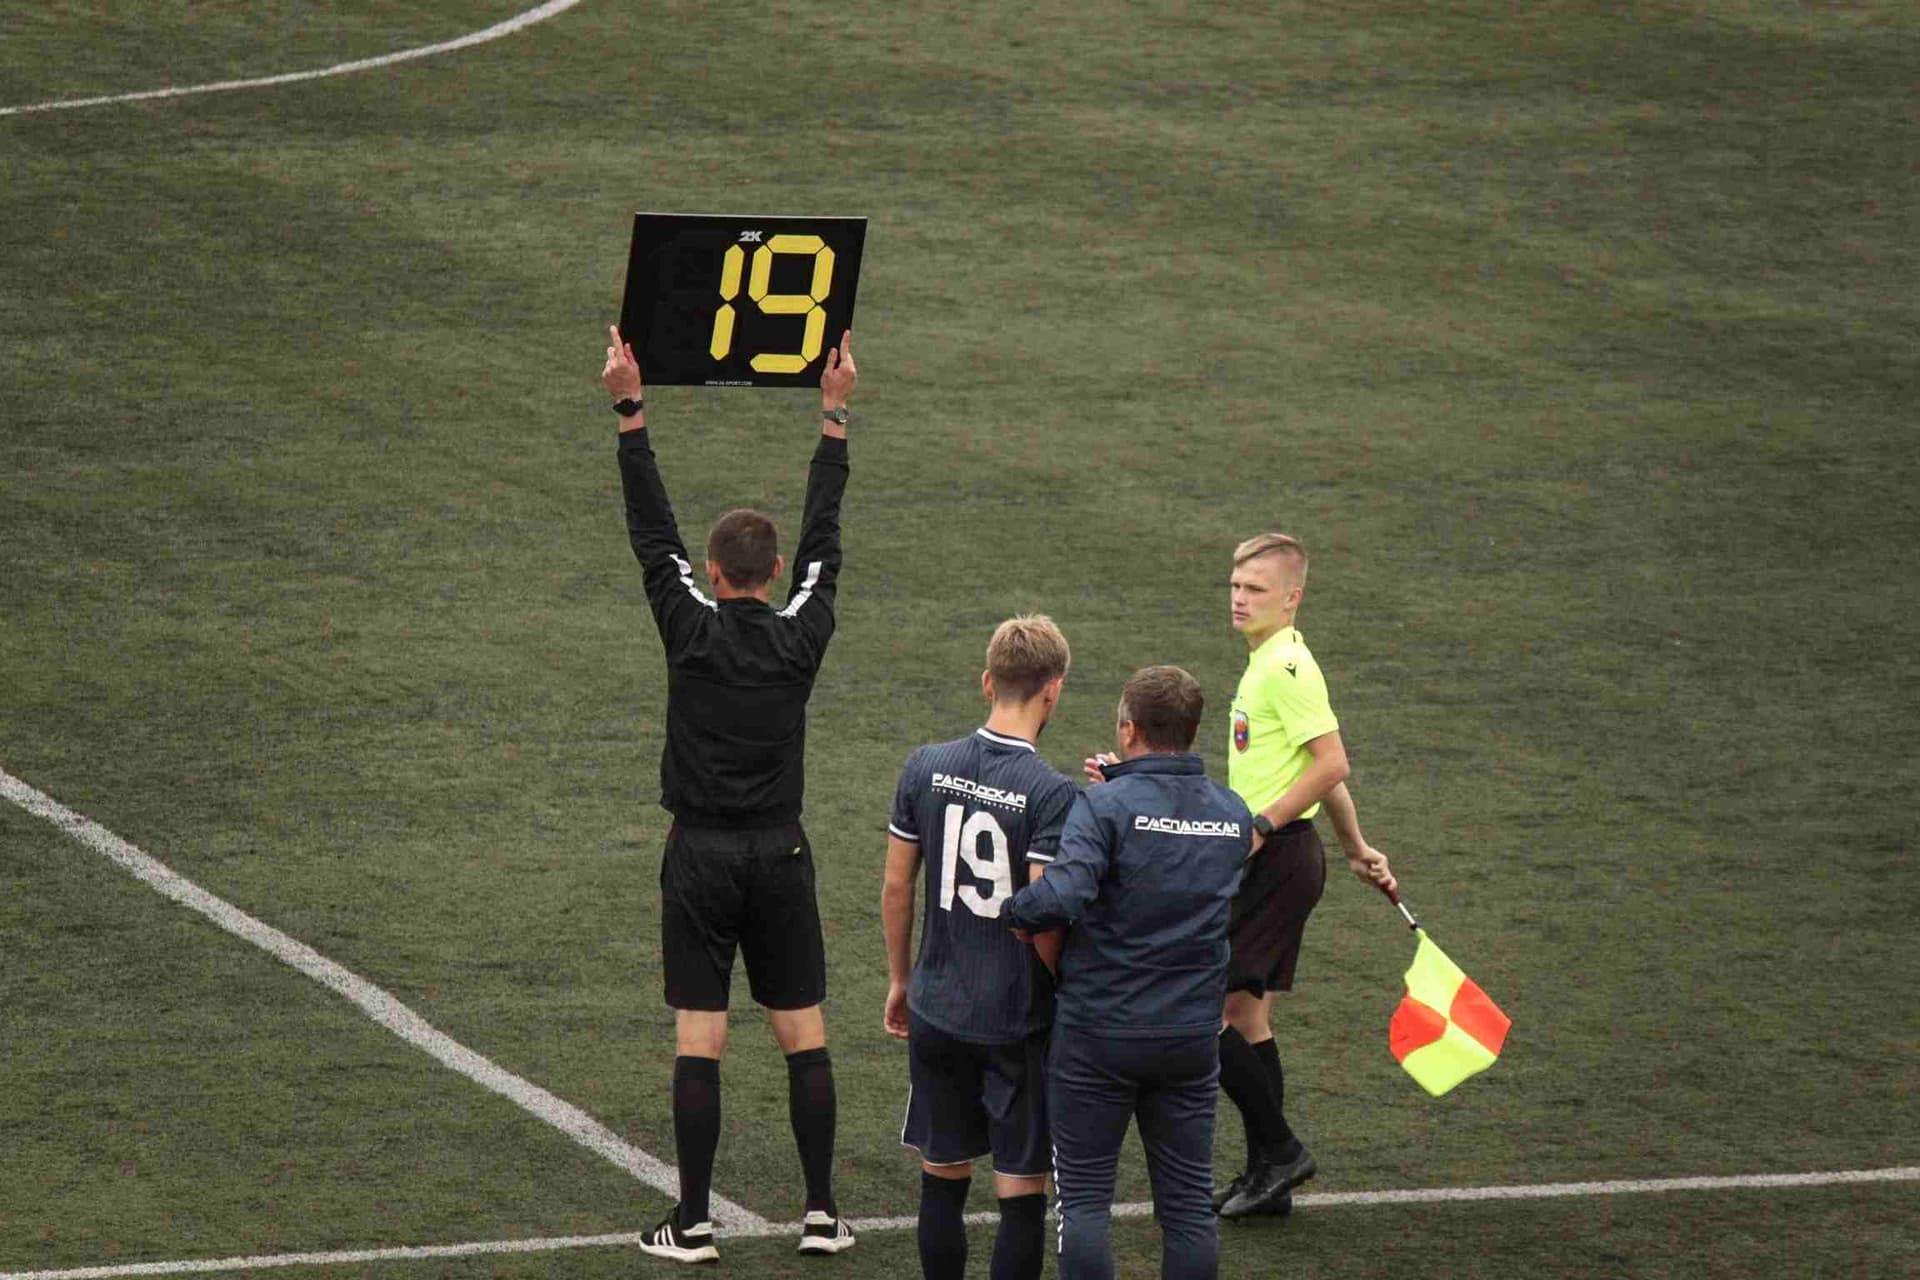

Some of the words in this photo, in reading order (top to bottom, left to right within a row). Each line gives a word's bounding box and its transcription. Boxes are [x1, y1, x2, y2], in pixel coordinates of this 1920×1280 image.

[738, 231, 763, 242] 2K
[710, 234, 835, 374] 19
[939, 803, 1013, 919] 19
